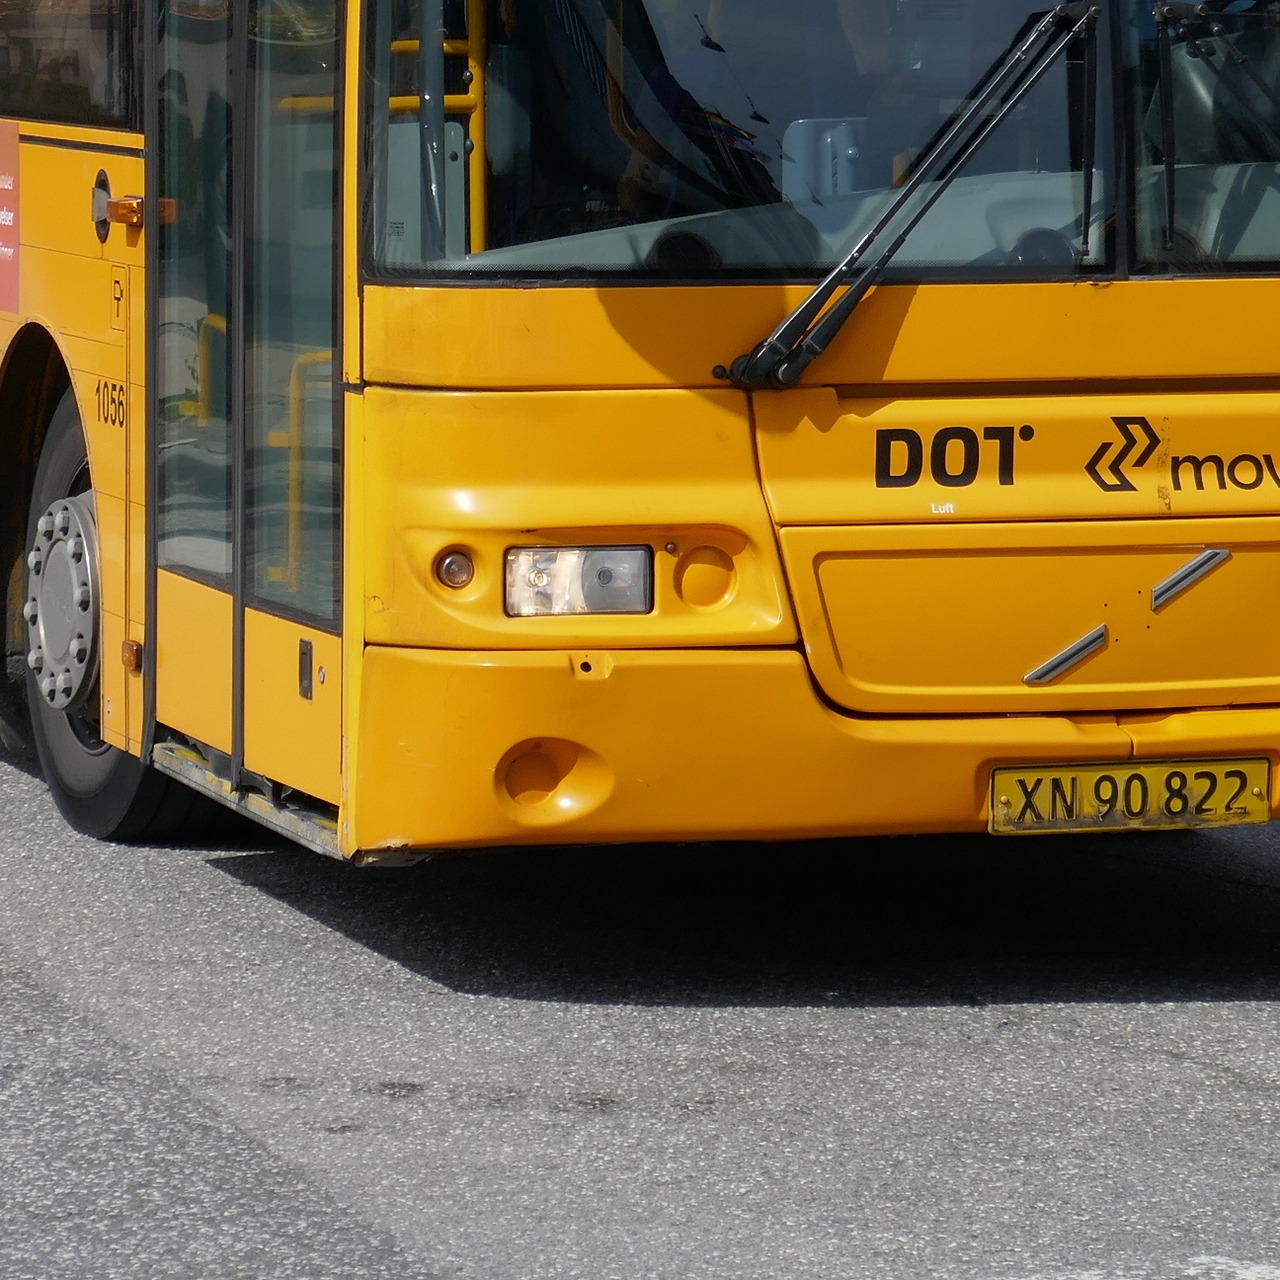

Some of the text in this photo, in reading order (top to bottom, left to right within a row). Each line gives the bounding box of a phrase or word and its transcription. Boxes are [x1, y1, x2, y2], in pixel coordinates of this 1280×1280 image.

[95, 379, 125, 428] 1056
[874, 425, 1034, 489] DOT
[931, 503, 955, 514] Luft
[1014, 769, 1249, 823] XN 90 822
